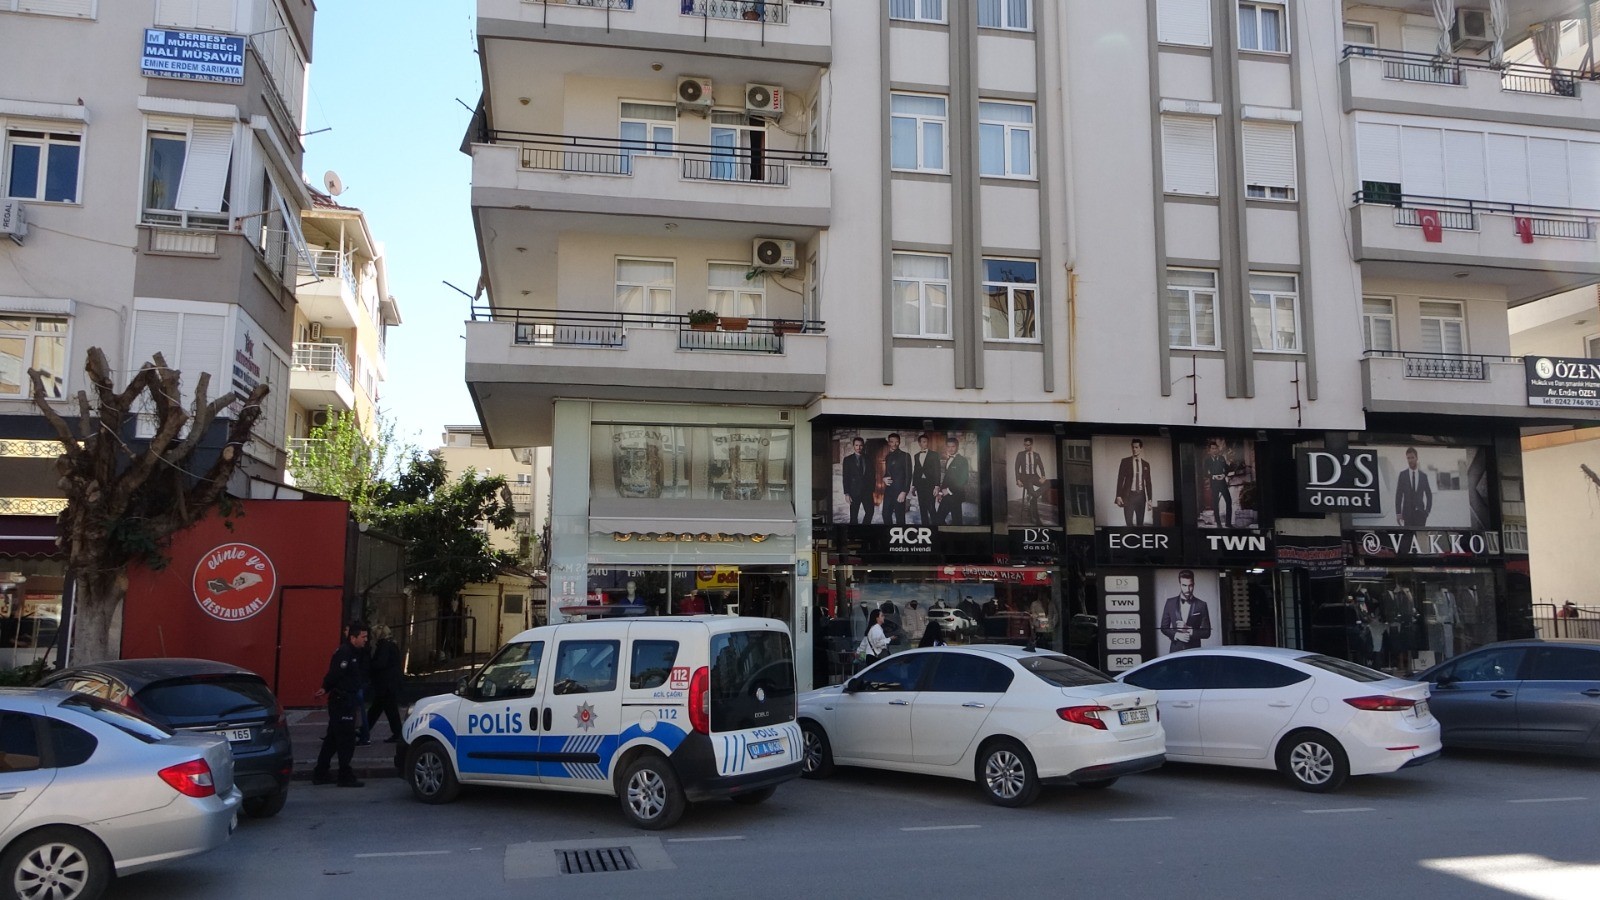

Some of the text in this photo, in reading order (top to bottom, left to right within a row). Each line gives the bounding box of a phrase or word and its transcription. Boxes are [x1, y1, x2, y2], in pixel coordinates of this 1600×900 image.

[168, 39, 237, 51] MUHASEBECİ
[178, 32, 227, 43] SERBEST
[146, 46, 242, 62] MALİ MÜŞAVİR
[144, 59, 240, 75] EMİNE ERDEM SARIKAYA
[3, 203, 12, 228] REGAL
[1555, 360, 1600, 379] ÖZEN
[613, 430, 670, 443] STEFANO
[1307, 452, 1374, 488] D'S
[1310, 491, 1371, 507] damat
[1024, 528, 1050, 543] D'S
[1109, 533, 1169, 549] ECER
[1206, 535, 1266, 551] TWN
[1388, 533, 1485, 554] VAKKO
[245, 555, 266, 571] ye
[202, 596, 264, 618] RESTAURANT
[673, 669, 688, 681] 112
[468, 706, 522, 734] POLİS
[658, 709, 677, 719] 112
[232, 730, 250, 740] 165
[762, 743, 769, 753] A
